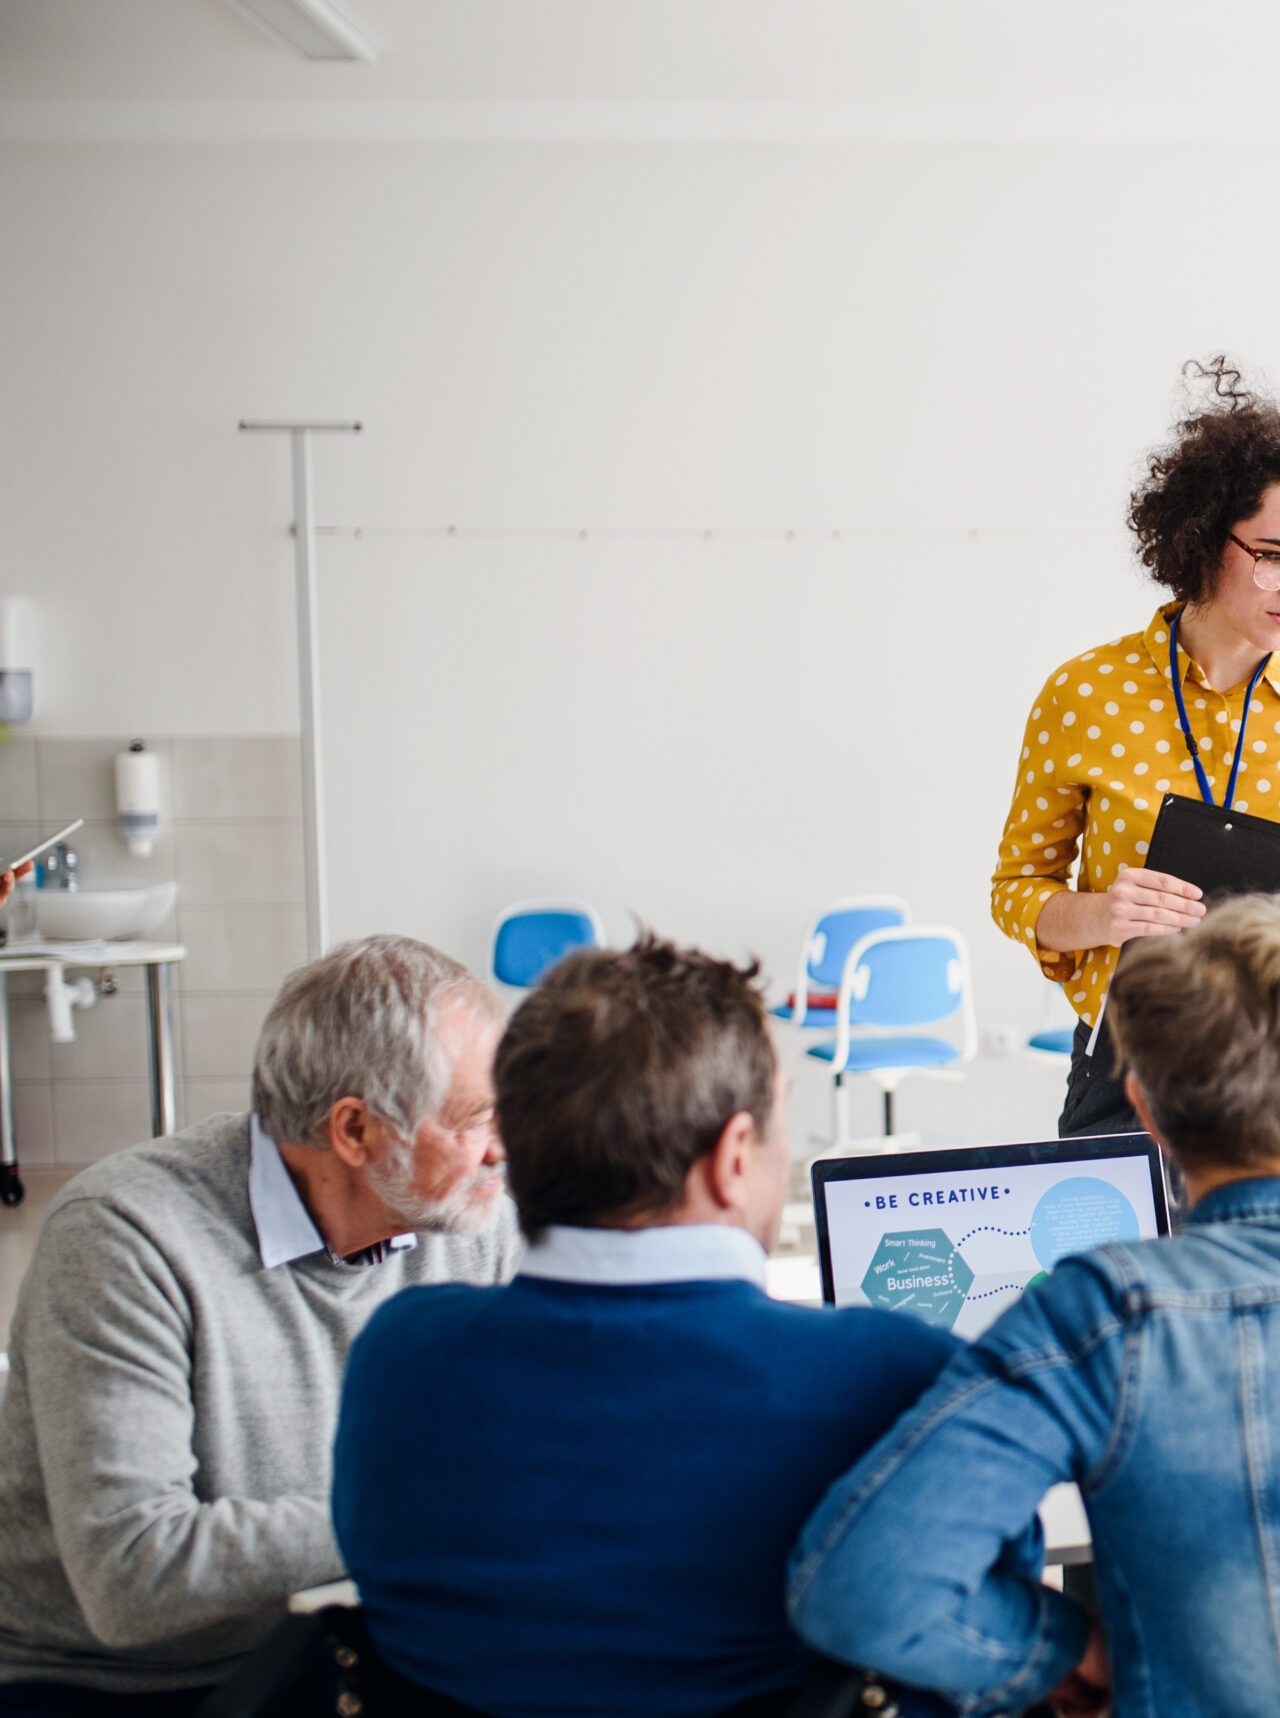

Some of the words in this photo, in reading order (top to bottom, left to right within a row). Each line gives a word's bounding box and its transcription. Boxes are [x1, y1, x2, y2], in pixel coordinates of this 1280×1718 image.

[875, 1194, 899, 1210] BE
[908, 1185, 1000, 1207] CREATIVE
[884, 1238, 906, 1247] Smart
[908, 1238, 937, 1249] Thinking
[873, 1258, 897, 1275] Work
[886, 1274, 950, 1291] Business
